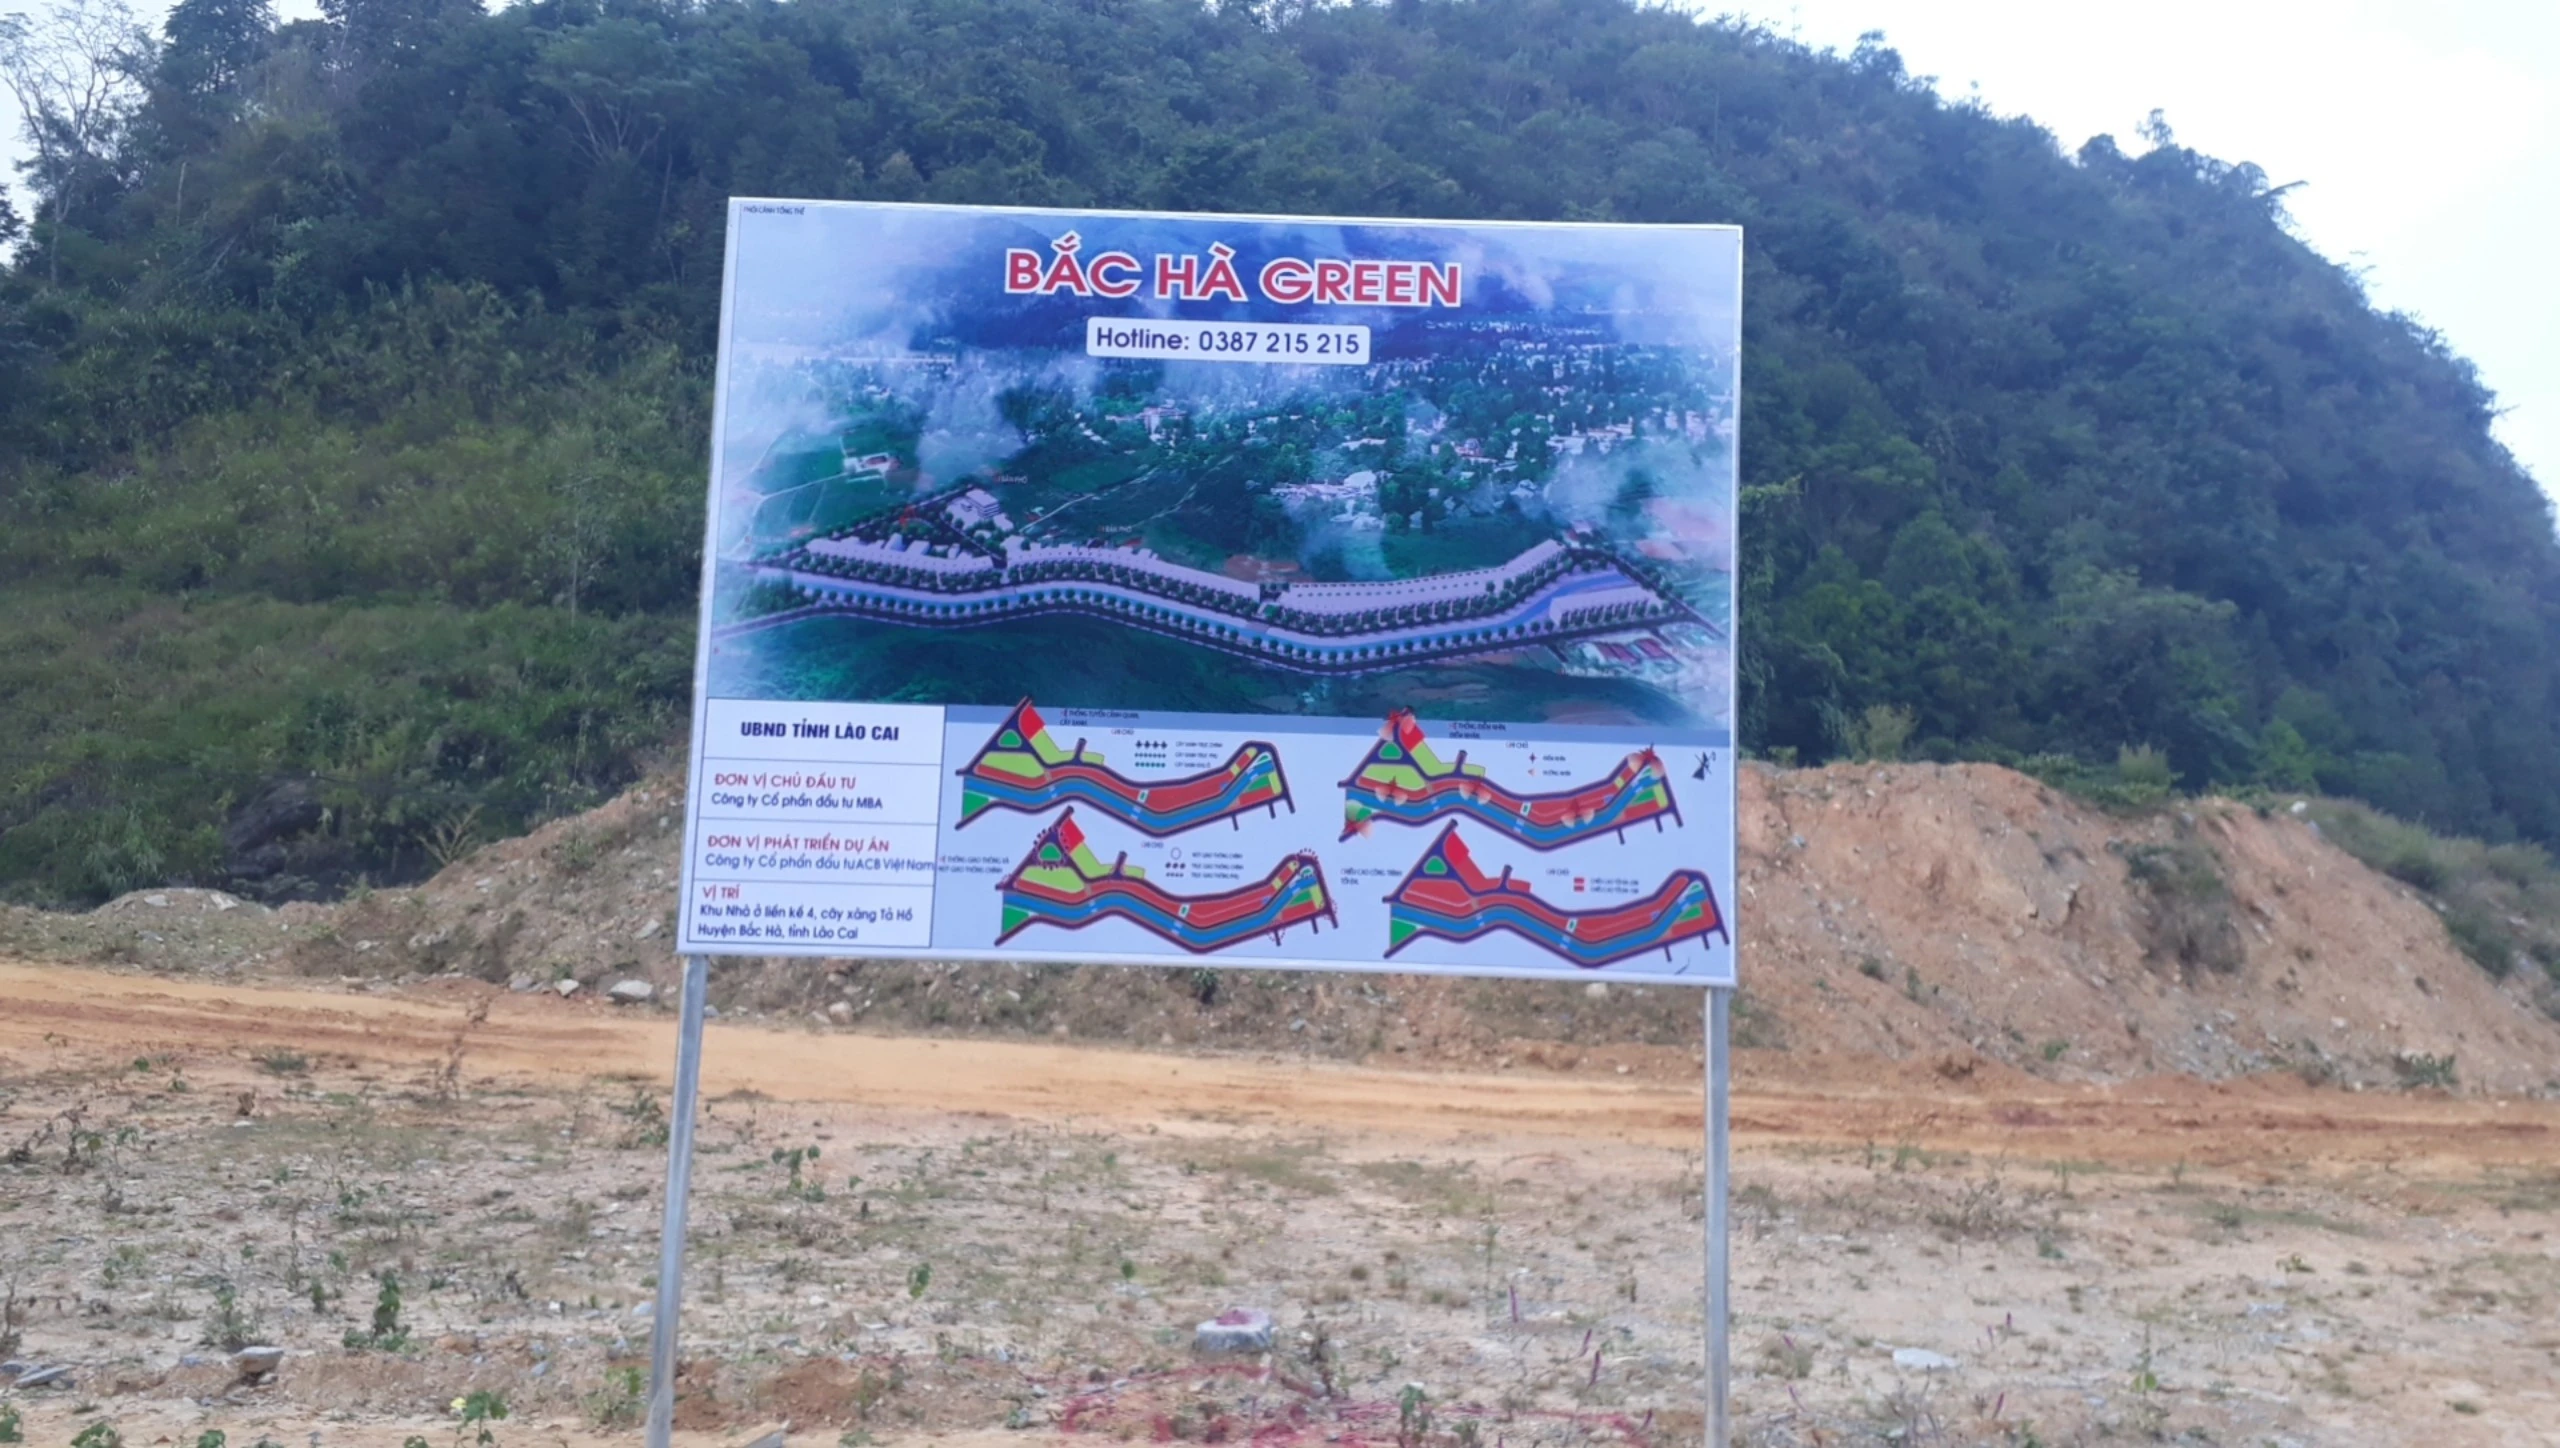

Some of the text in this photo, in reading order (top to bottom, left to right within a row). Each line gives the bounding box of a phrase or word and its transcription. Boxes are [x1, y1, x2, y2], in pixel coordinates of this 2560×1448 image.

[1005, 230, 1462, 308] BẮC HÀ GREEN
[1096, 326, 1359, 355] Hotline: 0387 215 215
[741, 718, 900, 741] UBND TỈNH LÀO CAI
[714, 772, 748, 787] ĐƠN
[753, 773, 766, 788] VỊ
[771, 770, 801, 788] CHỦ
[711, 792, 745, 808] Công
[747, 794, 757, 808] ty
[856, 797, 883, 809] MBA
[707, 834, 741, 849] ĐƠN
[746, 835, 759, 850] VỊ
[764, 834, 799, 850] PHÁT
[804, 832, 840, 851] TRIỂN
[868, 837, 890, 853] ÁN
[705, 853, 740, 870] Công
[743, 854, 755, 870] ty
[702, 884, 740, 900] VỊ TRÍ
[699, 903, 722, 918] Khu
[726, 904, 750, 918] Nhà
[697, 922, 736, 939] Huyện
[739, 921, 762, 938] Bắc
[837, 926, 859, 940] Cai
